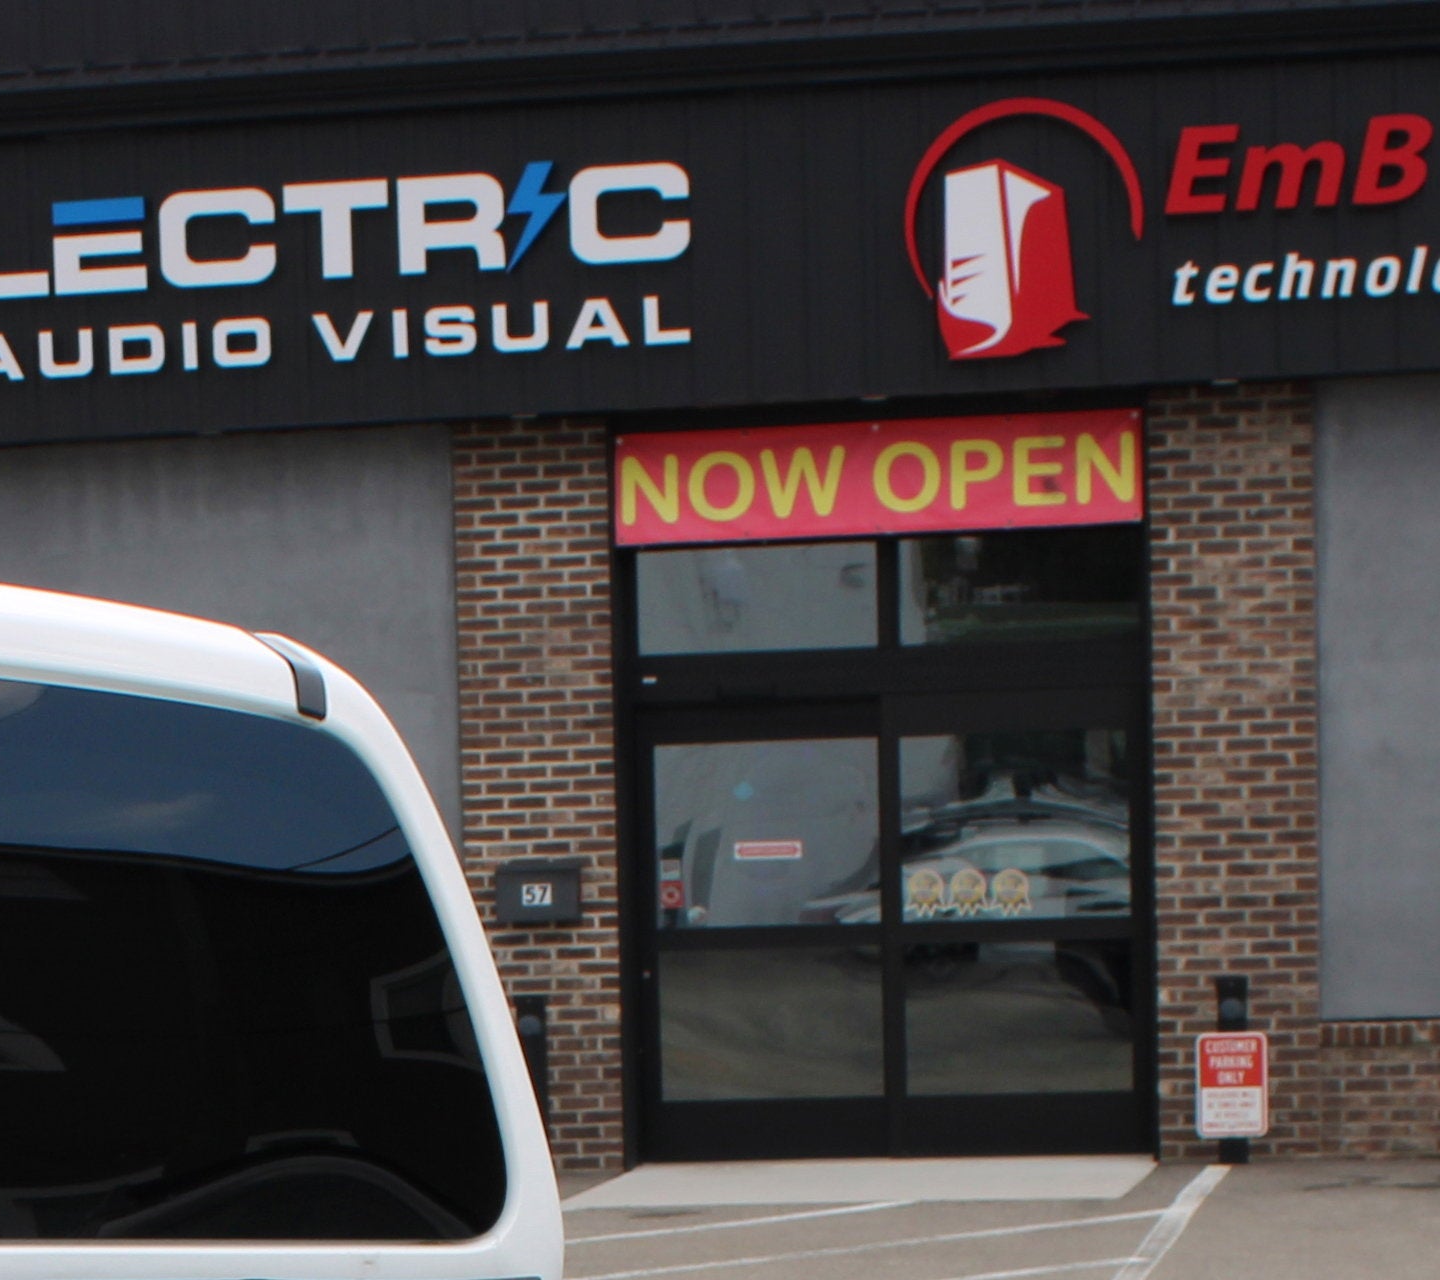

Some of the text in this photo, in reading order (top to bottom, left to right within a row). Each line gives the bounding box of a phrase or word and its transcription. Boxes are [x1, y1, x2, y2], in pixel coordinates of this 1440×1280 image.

[1164, 113, 1434, 214] EmB
[313, 296, 691, 360] VISUAL
[621, 430, 1135, 526] NOW OPEN
[525, 885, 548, 904] 57
[1206, 1039, 1258, 1053] CUSTOMER
[1209, 1055, 1253, 1069] PARKING
[1217, 1071, 1245, 1085] ONLY
